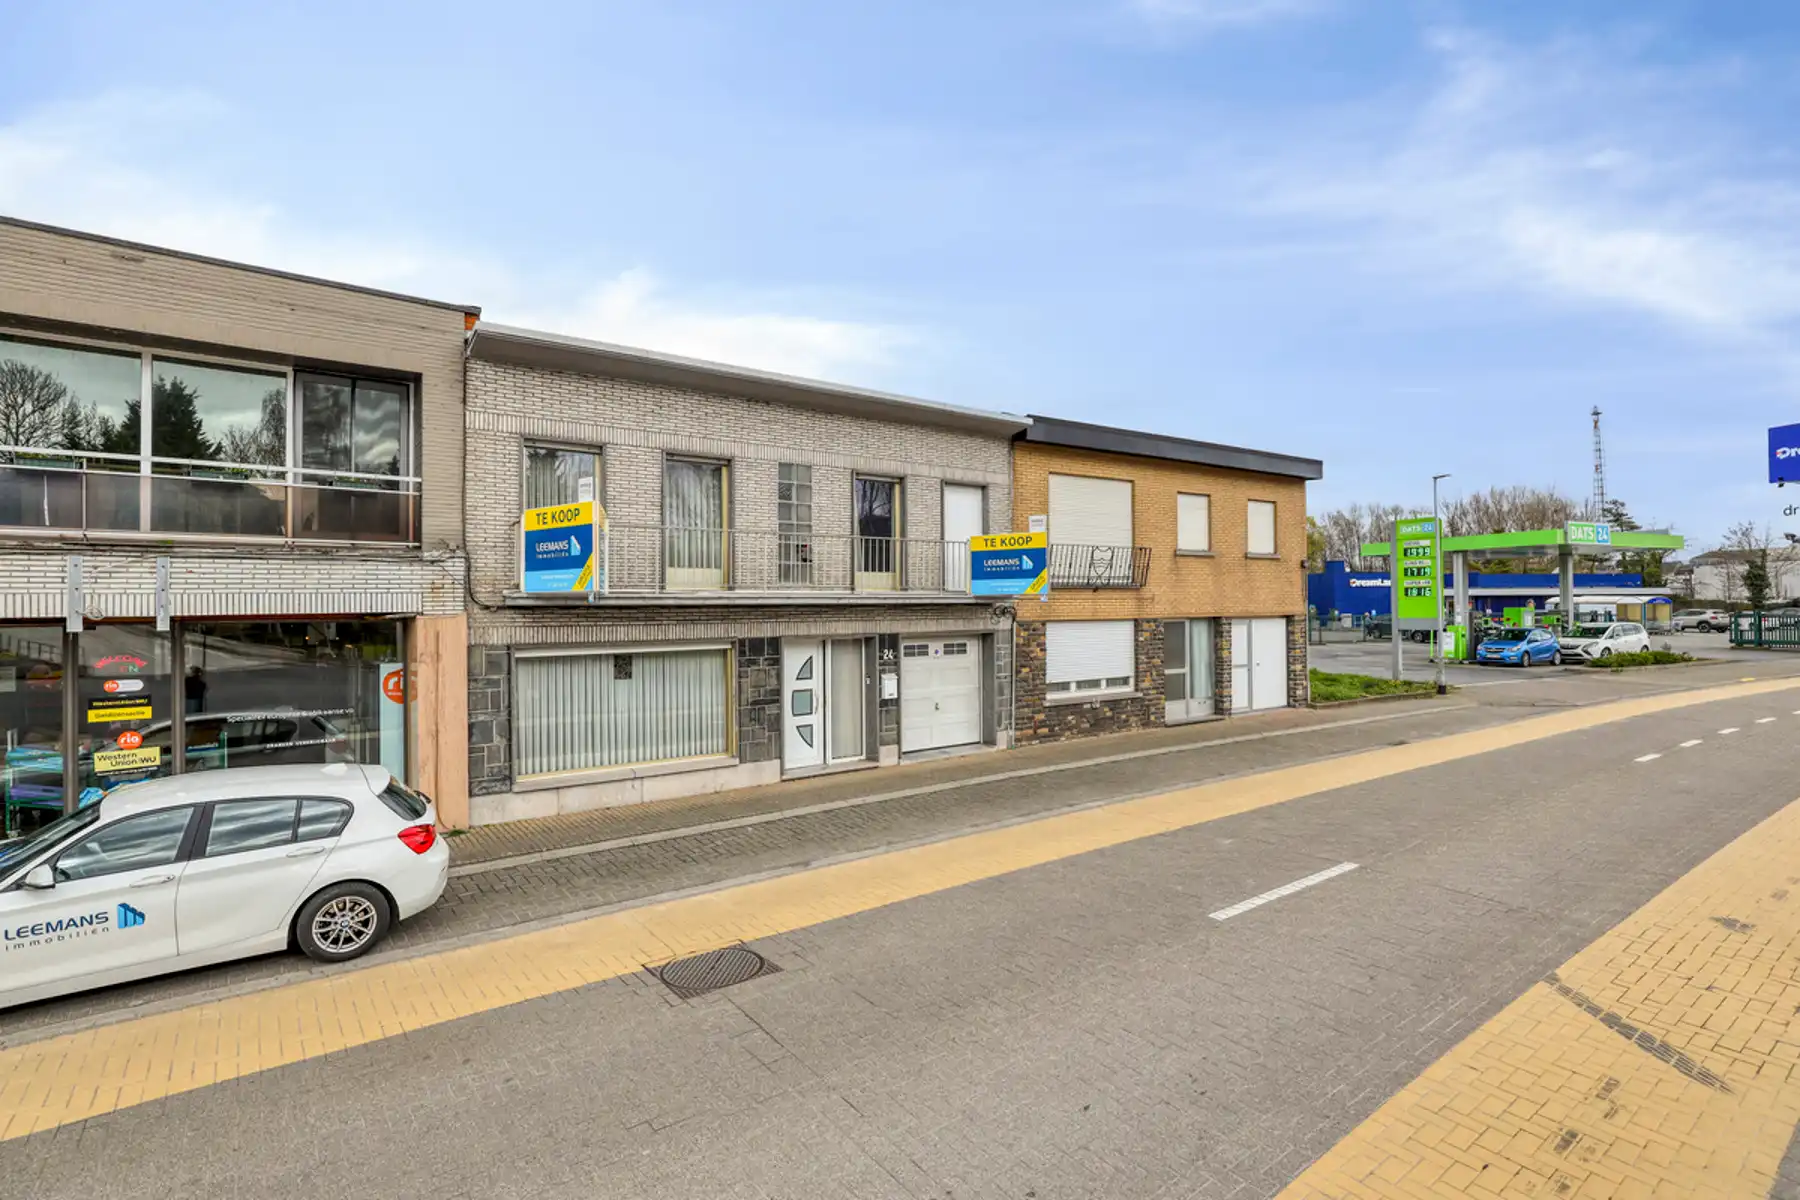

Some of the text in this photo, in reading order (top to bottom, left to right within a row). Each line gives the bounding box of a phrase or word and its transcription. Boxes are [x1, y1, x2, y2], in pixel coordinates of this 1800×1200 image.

[536, 507, 580, 526] TE KOOP
[1571, 526, 1609, 541] DATS 24
[535, 540, 569, 552] LEEMANS
[983, 536, 1033, 548] TE KOOP
[983, 558, 1020, 566] LEEMANS
[883, 648, 894, 660] 24
[97, 752, 138, 762] Western
[110, 758, 137, 767] Union
[4, 911, 109, 941] LEEMANS
